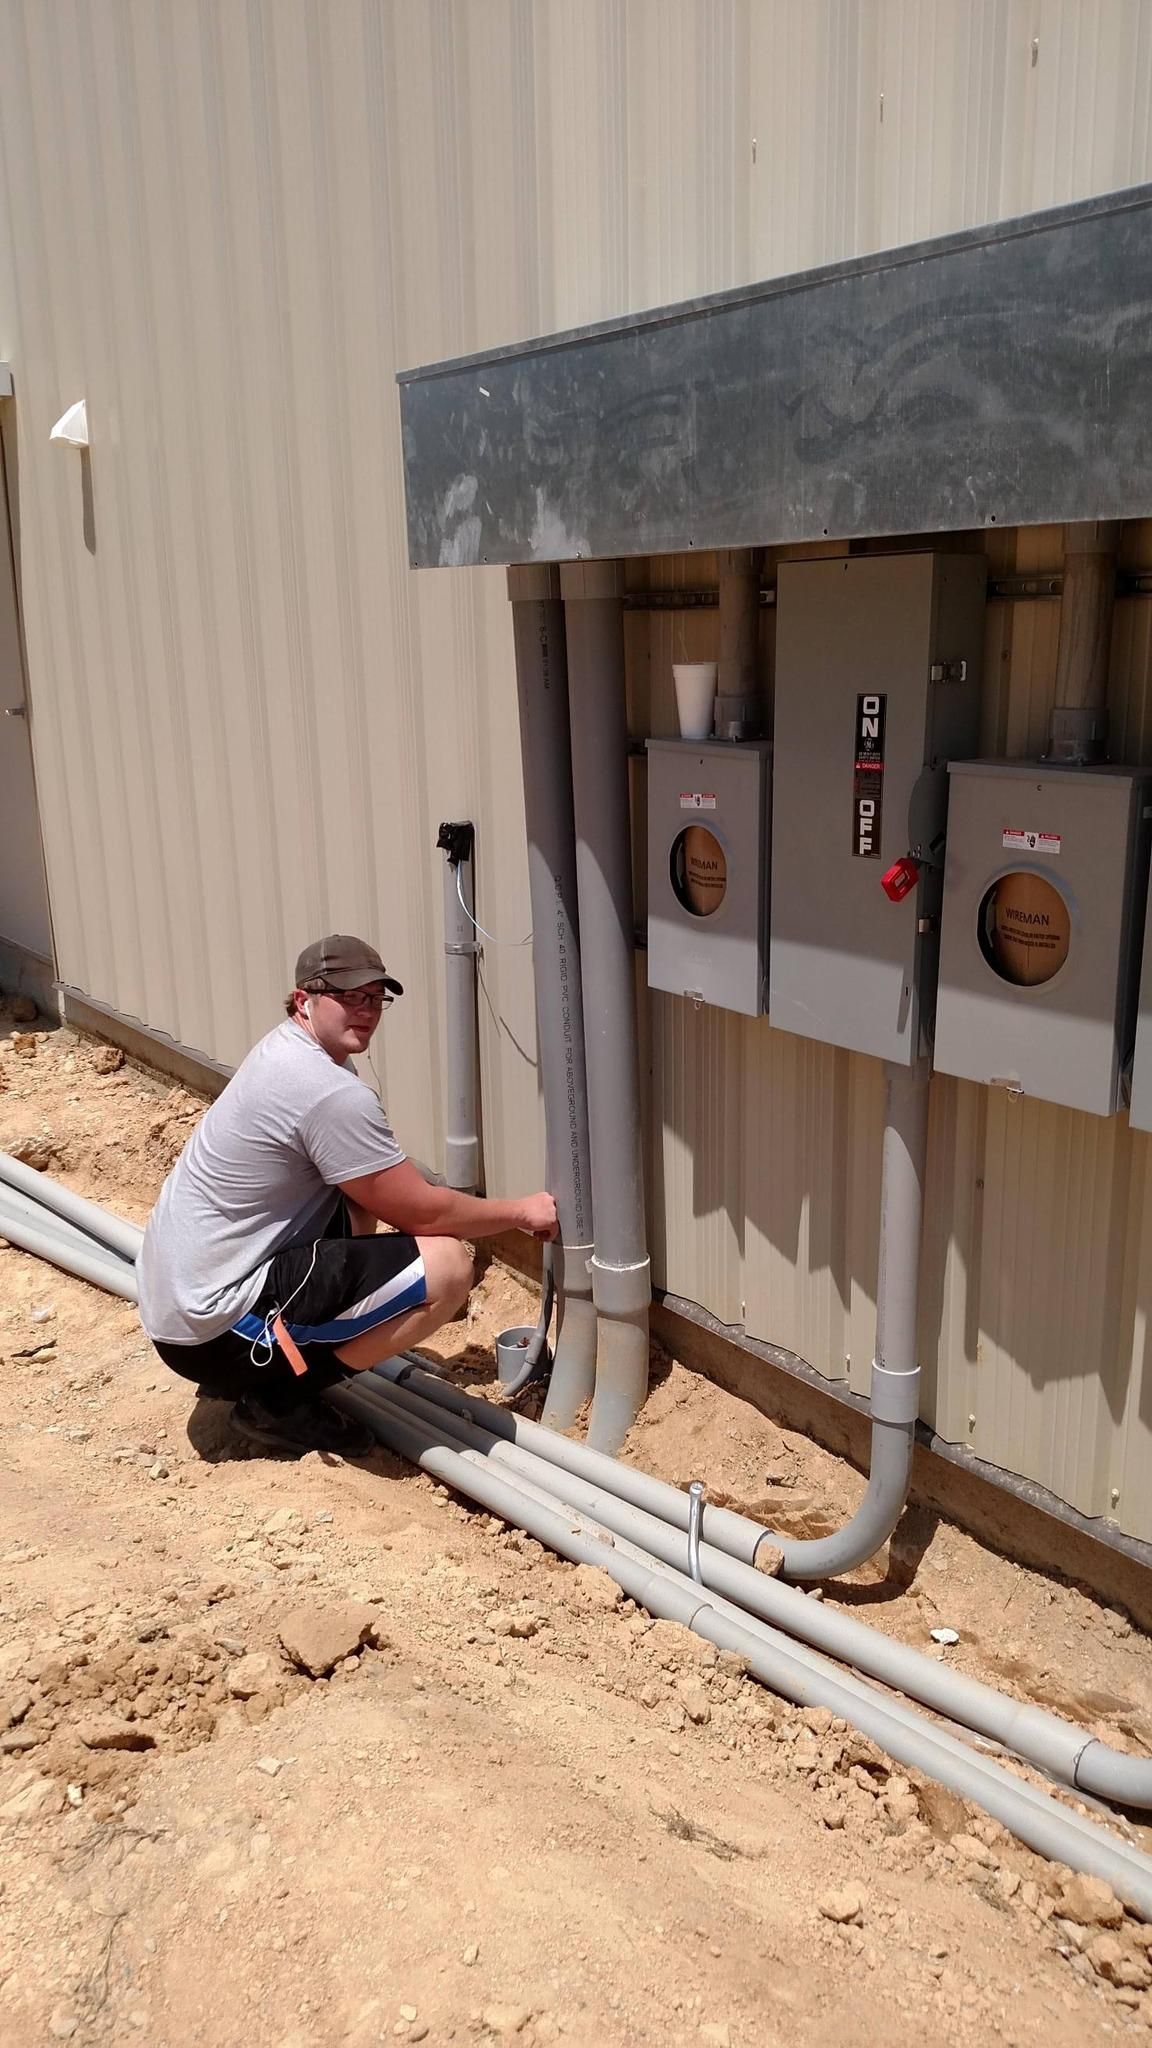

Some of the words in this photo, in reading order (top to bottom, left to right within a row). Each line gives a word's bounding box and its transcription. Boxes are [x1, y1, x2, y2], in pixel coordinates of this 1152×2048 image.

[862, 696, 880, 738] ON
[859, 799, 875, 855] OFF
[1006, 908, 1050, 926] WIREMAN
[558, 944, 566, 954] 40
[559, 958, 568, 981] RIGID
[562, 1006, 572, 1043] CONDUIT
[565, 1047, 573, 1064] FOR
[566, 1067, 578, 1129] ABOVEGROUND
[570, 1131, 578, 1147] AND
[571, 1150, 582, 1212] UNDERGROUND
[576, 1213, 584, 1229] USE
